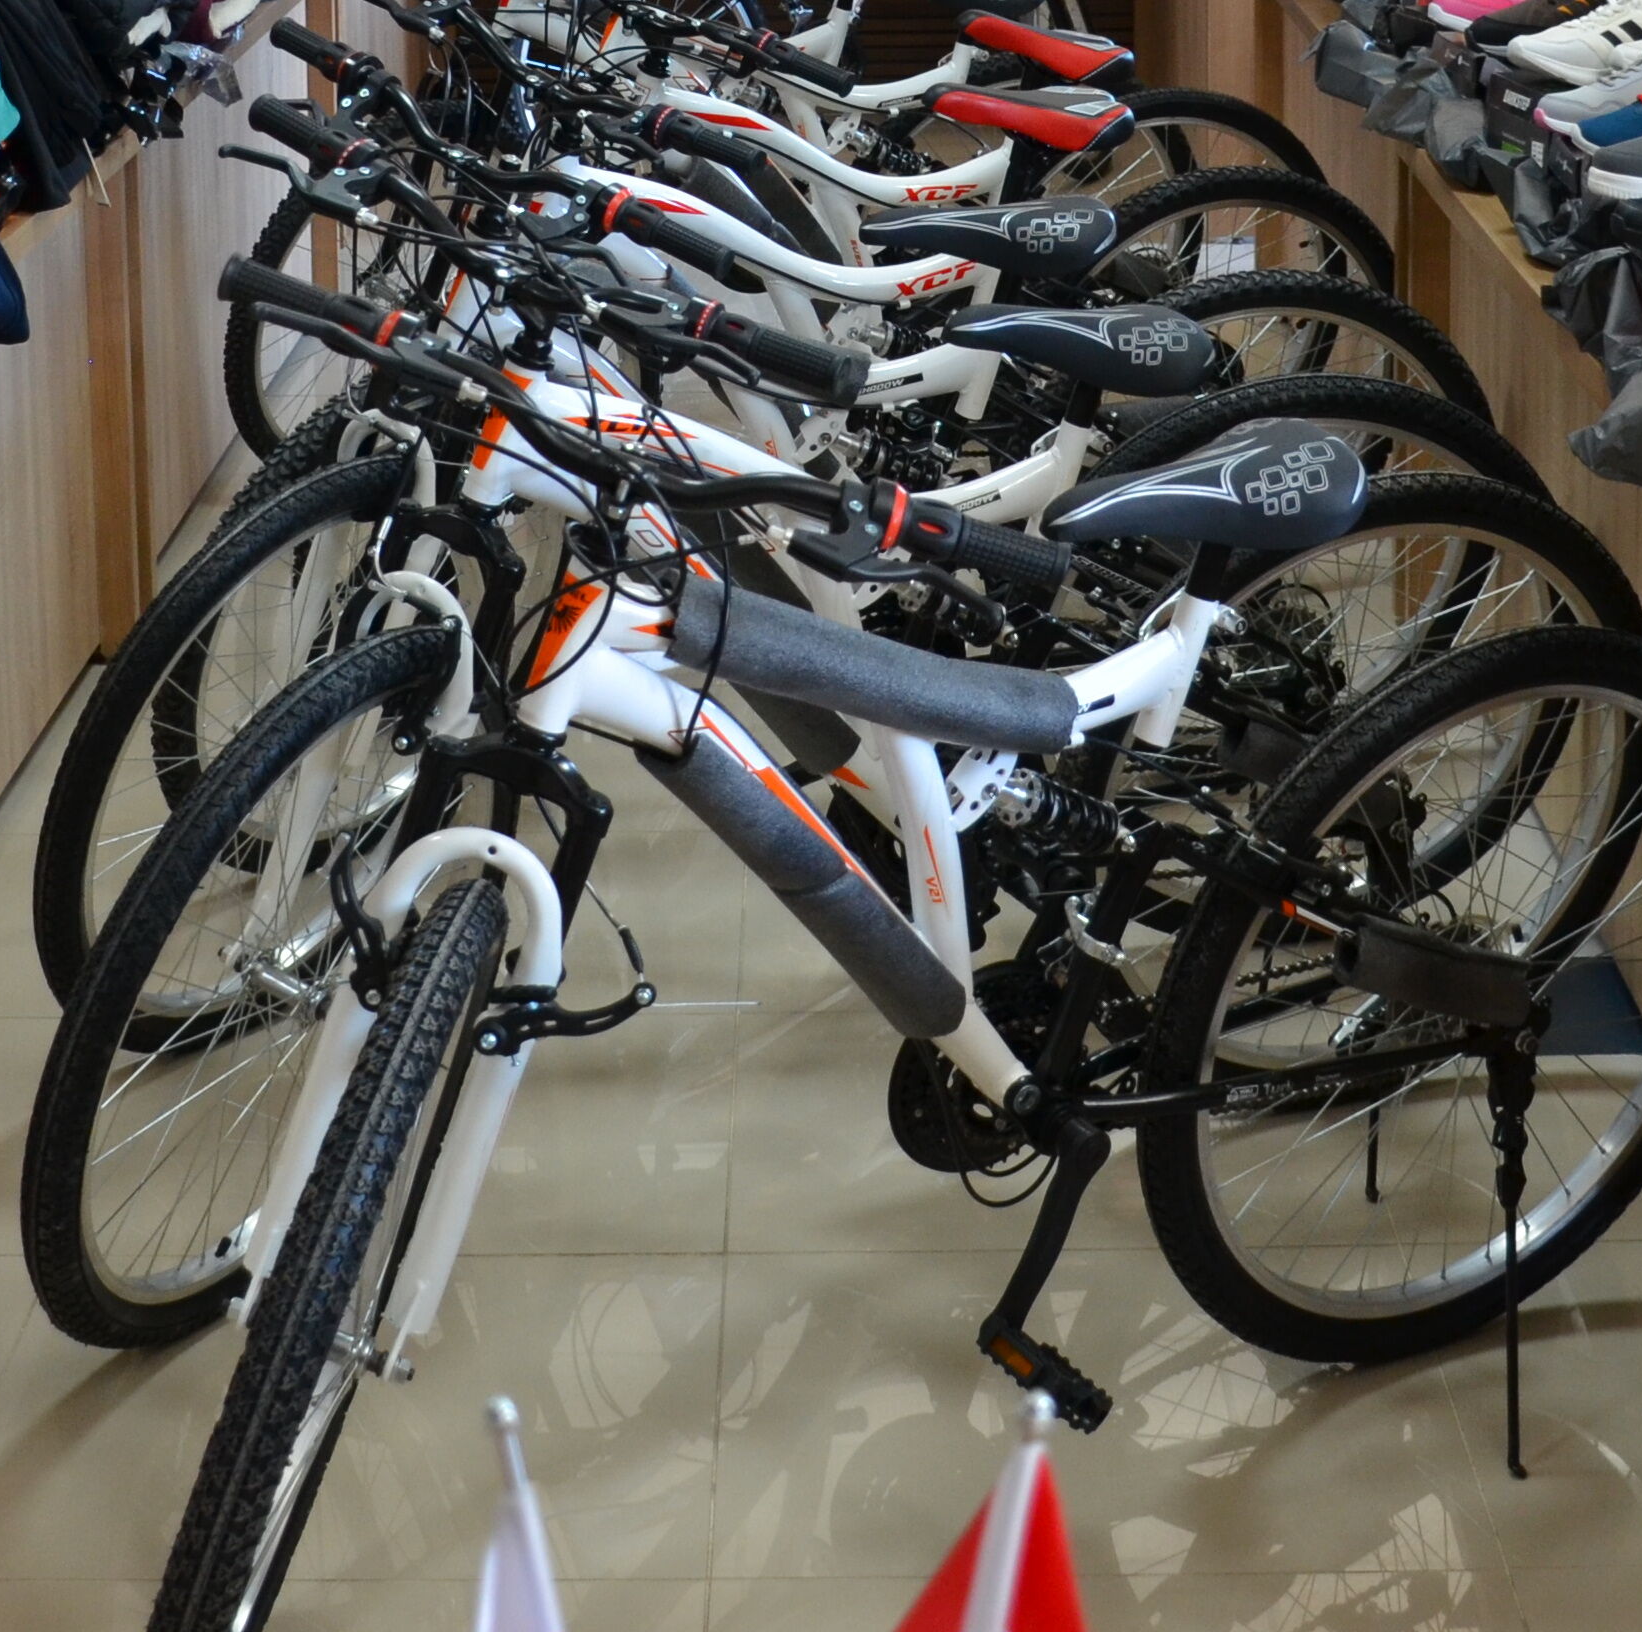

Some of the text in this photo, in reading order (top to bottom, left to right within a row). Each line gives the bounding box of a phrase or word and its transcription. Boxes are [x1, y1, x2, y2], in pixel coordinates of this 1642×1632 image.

[900, 184, 979, 203] XCF
[893, 260, 977, 300] XCF
[925, 876, 943, 904] V21
